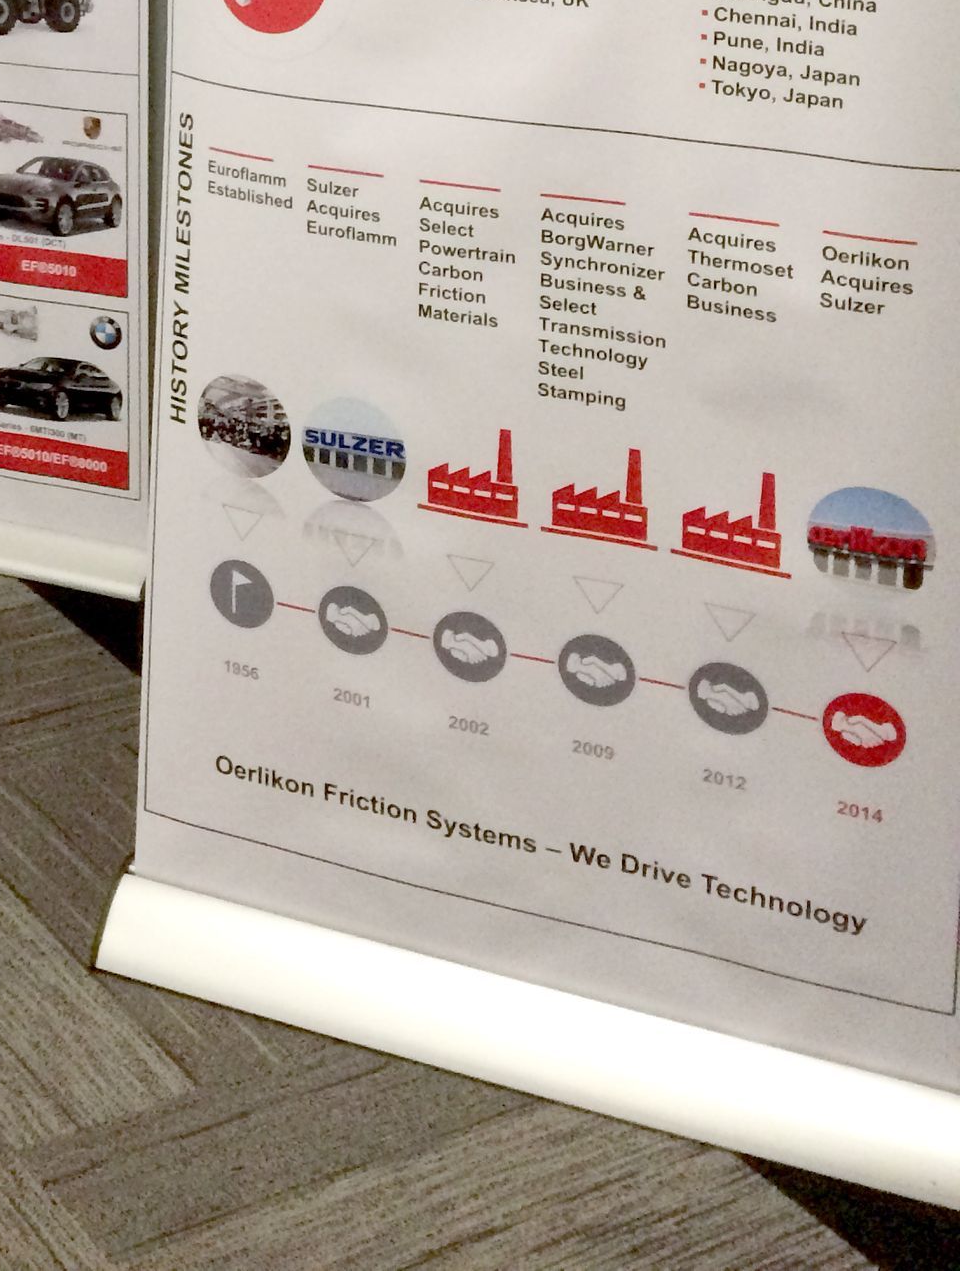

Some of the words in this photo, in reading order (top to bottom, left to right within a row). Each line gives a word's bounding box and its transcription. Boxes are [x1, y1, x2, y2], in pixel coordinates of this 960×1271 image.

[714, 7, 801, 31] Chennai,
[810, 16, 857, 35] India
[713, 55, 792, 80] Nagoya,
[800, 65, 860, 86] Japan
[712, 80, 776, 103] Tokyo,
[783, 88, 843, 109] Japan
[208, 160, 286, 187] Euroflamm
[208, 180, 293, 209] Established
[307, 178, 359, 197] Sulzer
[173, 112, 194, 295] MILESTONES
[307, 200, 380, 222] Acquires
[419, 197, 499, 218] Acquires
[307, 220, 396, 246] Euroflamm
[419, 218, 474, 237] Select
[420, 240, 515, 264] Powertrain
[541, 229, 654, 256] BorgWarner
[541, 251, 665, 280] Synchronizer
[688, 249, 793, 279] Thermoset
[822, 246, 909, 270] Oerlikon
[419, 261, 483, 282] Carbon
[688, 272, 757, 296] Carbon
[419, 283, 485, 304] Friction
[541, 273, 626, 297] Business
[633, 286, 646, 300] &
[419, 304, 498, 327] Materials
[687, 294, 776, 322] Business
[820, 293, 885, 314] Sulzer
[539, 317, 666, 348] Transmission
[170, 300, 190, 425] HISTORY
[538, 339, 648, 370] Technology
[538, 361, 583, 380] Steel
[538, 383, 625, 411] Stamping
[304, 429, 407, 459] SULZER
[225, 660, 259, 680] 1956
[333, 688, 370, 708] 2001
[449, 716, 489, 736] 2002
[572, 740, 616, 760] 2009
[703, 769, 747, 791] 2012
[837, 801, 883, 823] 2014
[216, 756, 314, 797] Oerlikon
[324, 783, 417, 823] Friction
[427, 810, 536, 853] Systems
[570, 843, 610, 868] We
[621, 853, 691, 888] Drive
[701, 874, 867, 935] Technology
